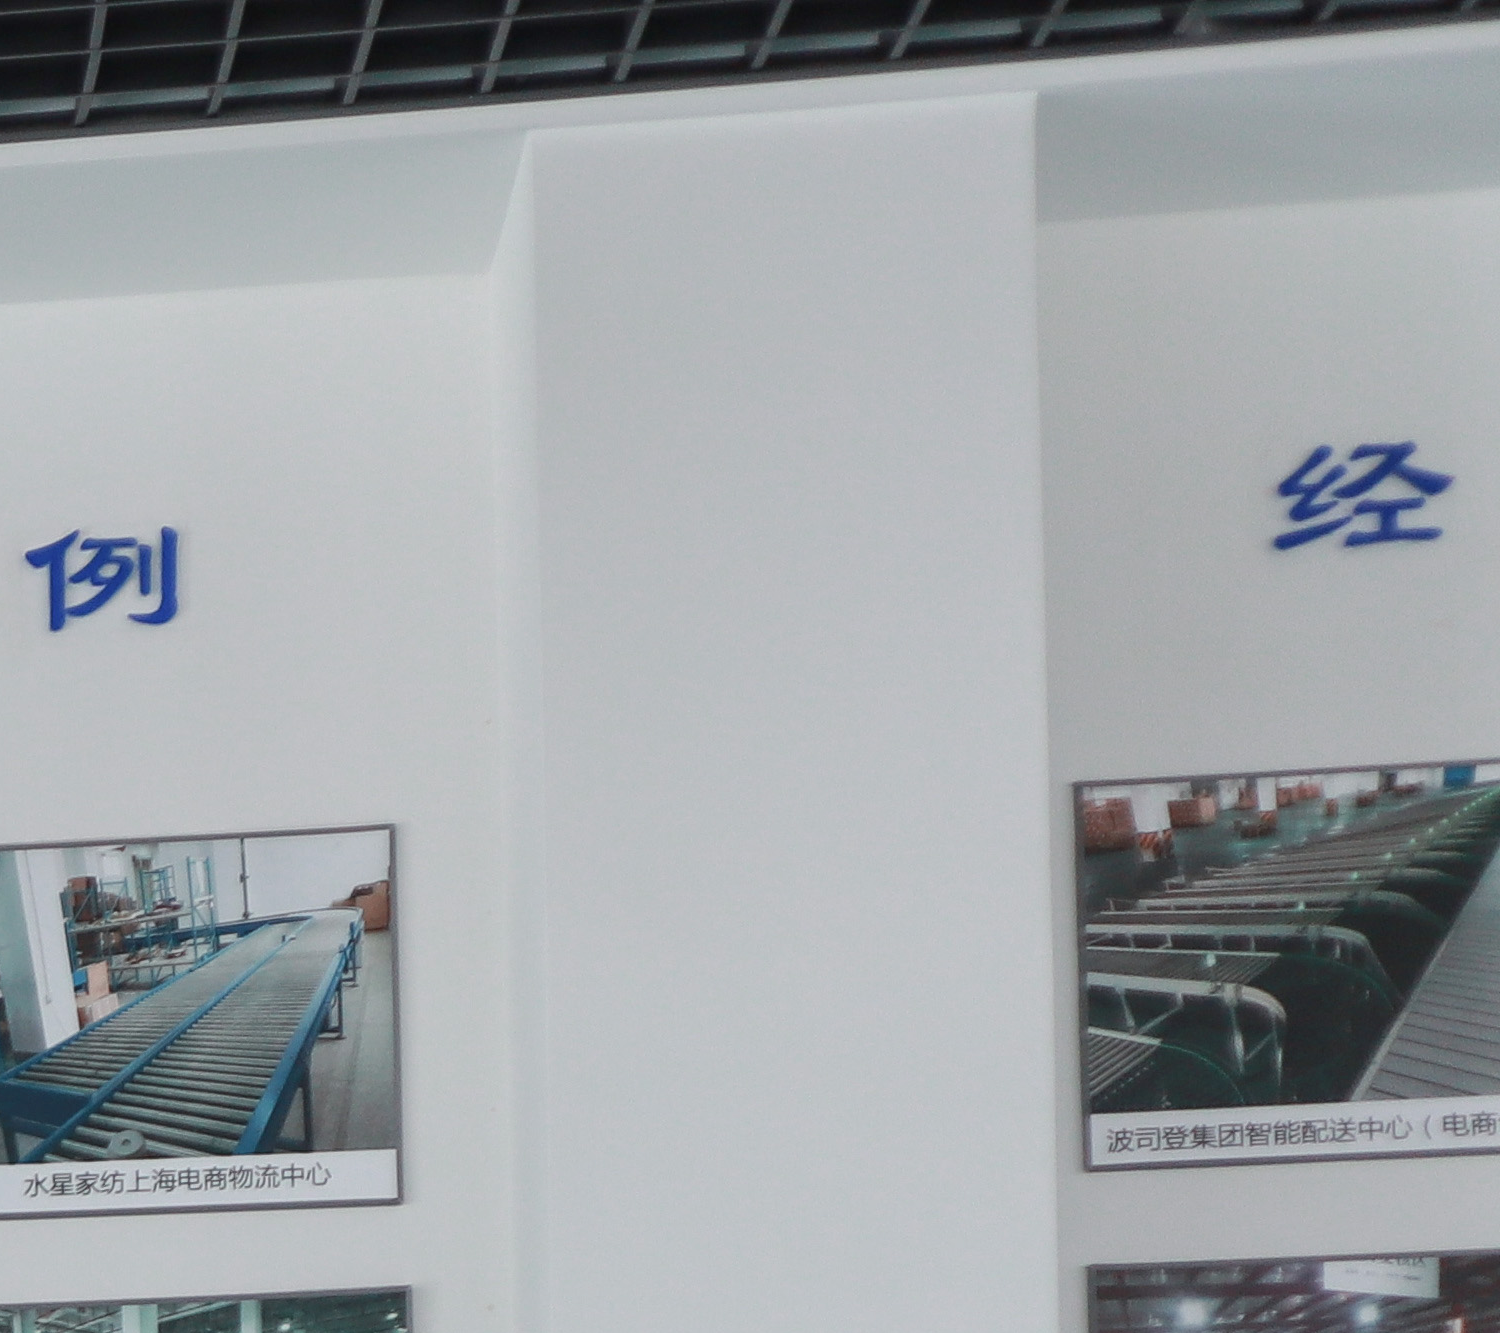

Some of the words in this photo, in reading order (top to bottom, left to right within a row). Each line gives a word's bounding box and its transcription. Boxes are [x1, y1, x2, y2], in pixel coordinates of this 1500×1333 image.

[1273, 440, 1456, 551] 经
[1106, 1110, 1500, 1154] 波司登集团智能配送中心（电商
[23, 1162, 332, 1200] 水星家纺上海电商物流中心
